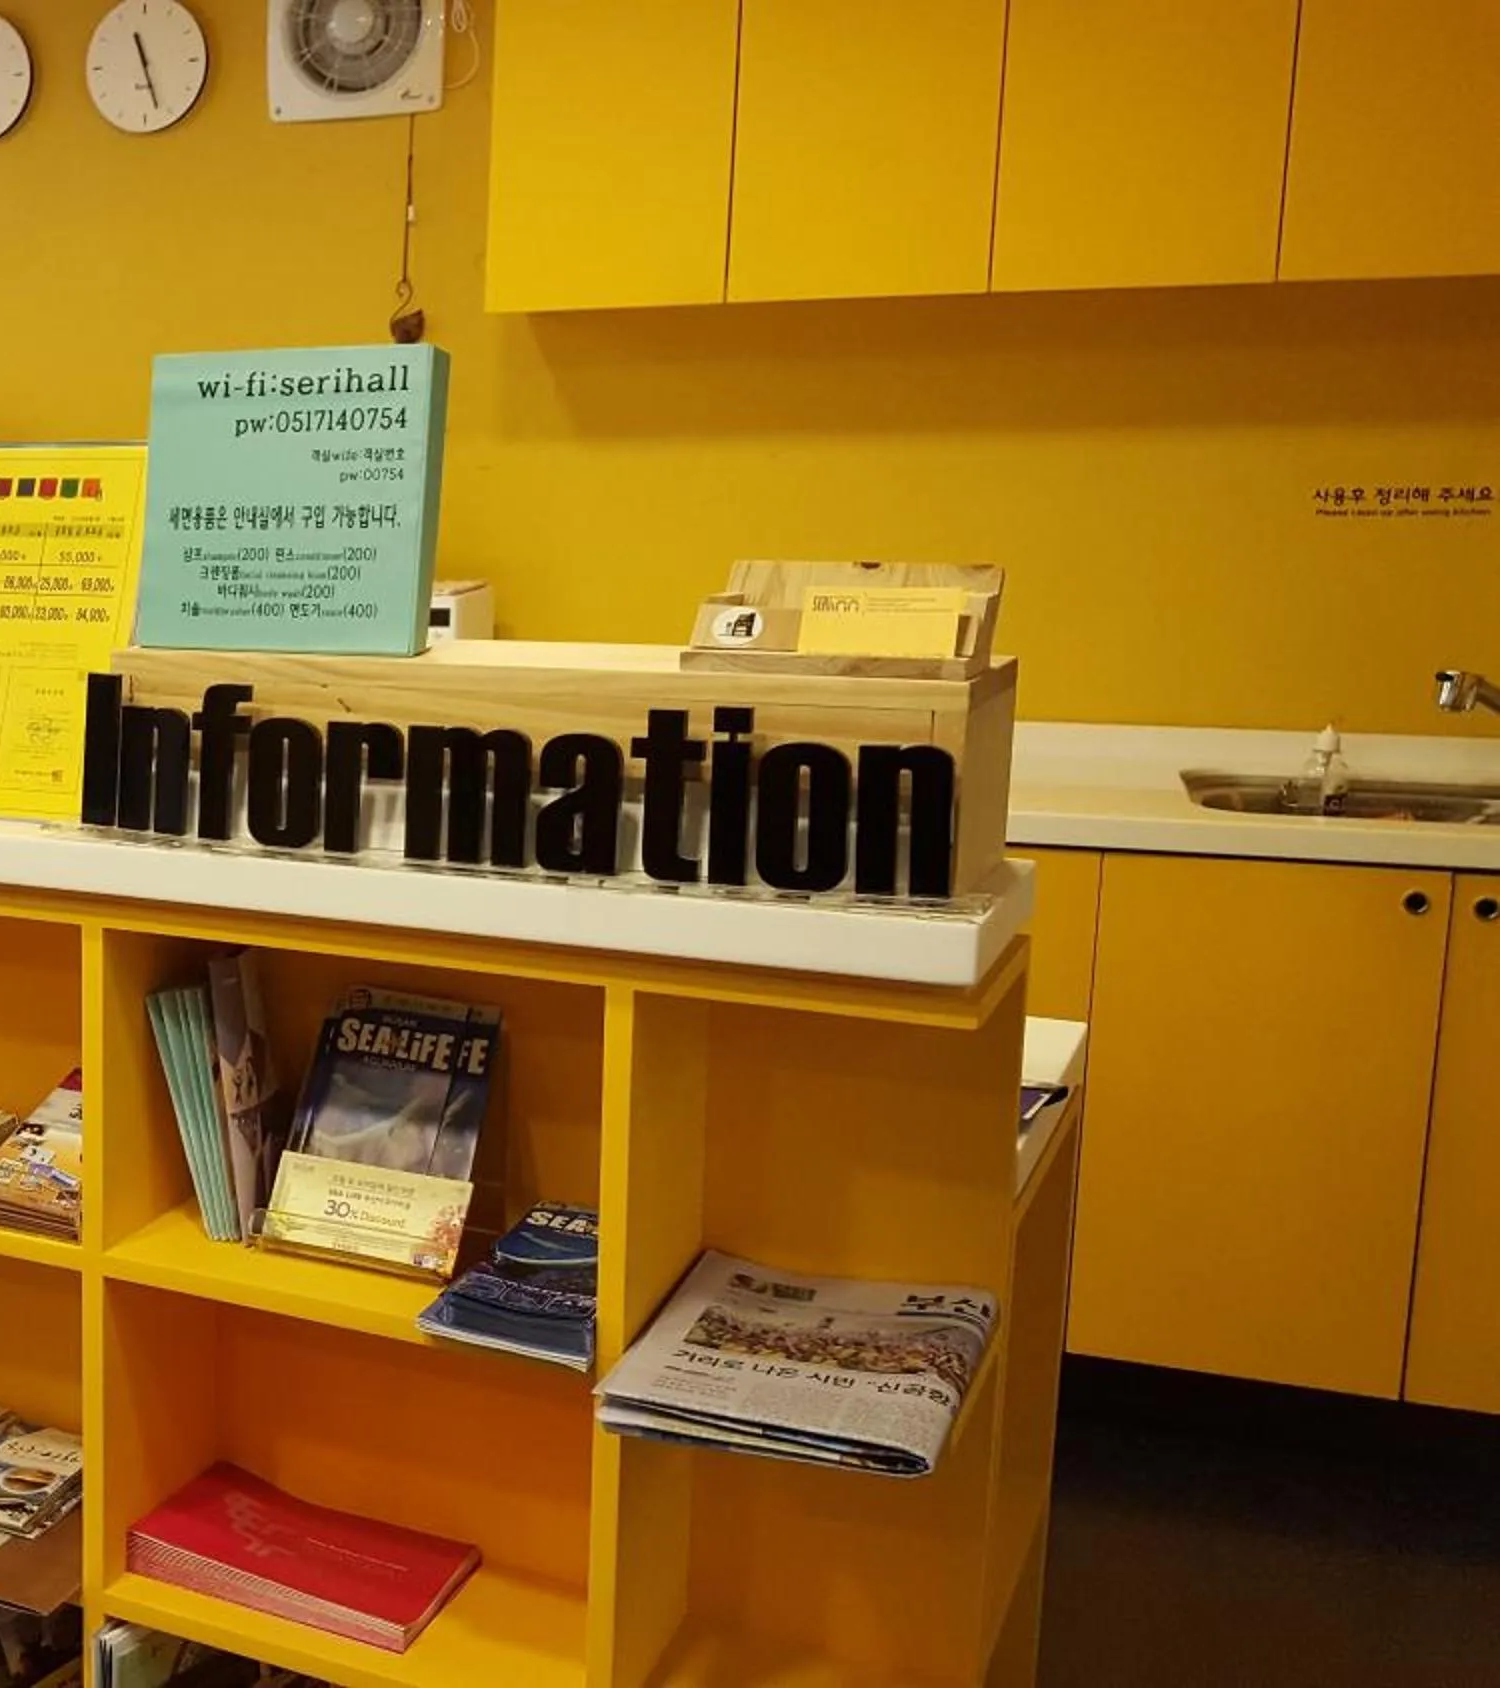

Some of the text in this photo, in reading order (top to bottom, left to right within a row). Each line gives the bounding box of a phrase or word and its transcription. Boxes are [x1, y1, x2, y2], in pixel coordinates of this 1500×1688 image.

[235, 407, 408, 437] pw:0517140754
[301, 504, 325, 529] 구입
[81, 673, 957, 898] Information
